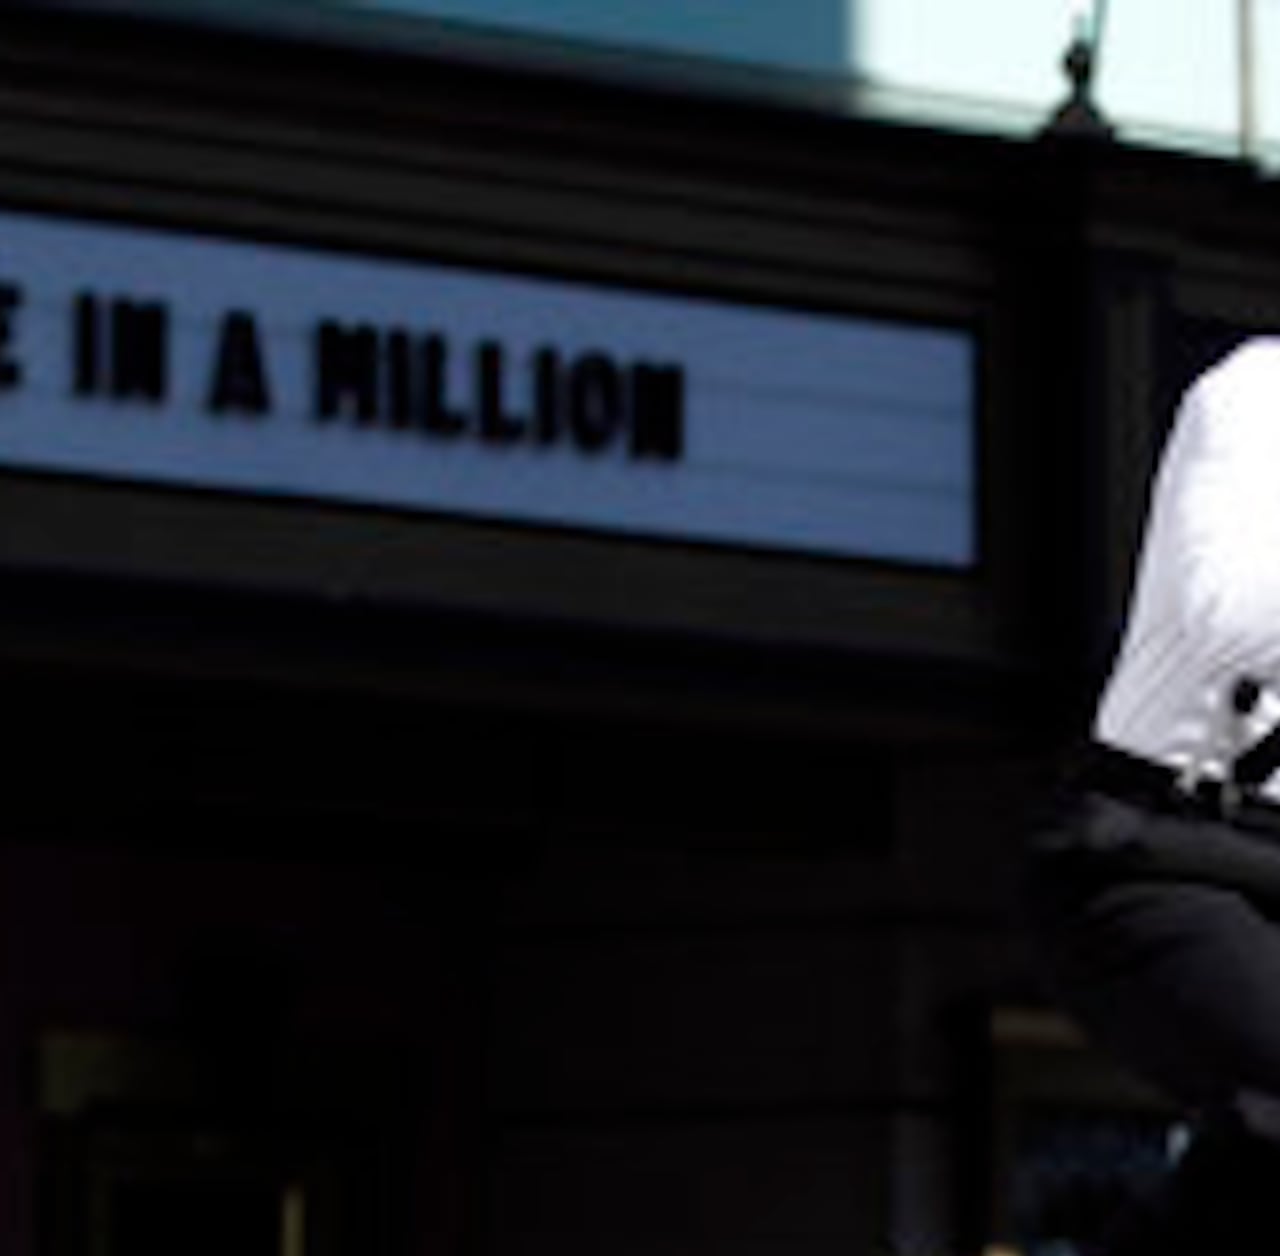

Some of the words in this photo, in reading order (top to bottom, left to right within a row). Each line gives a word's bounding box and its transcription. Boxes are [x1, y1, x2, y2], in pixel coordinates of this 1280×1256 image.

[72, 291, 170, 405] IN
[207, 310, 272, 417] A
[311, 318, 686, 464] MILLION
